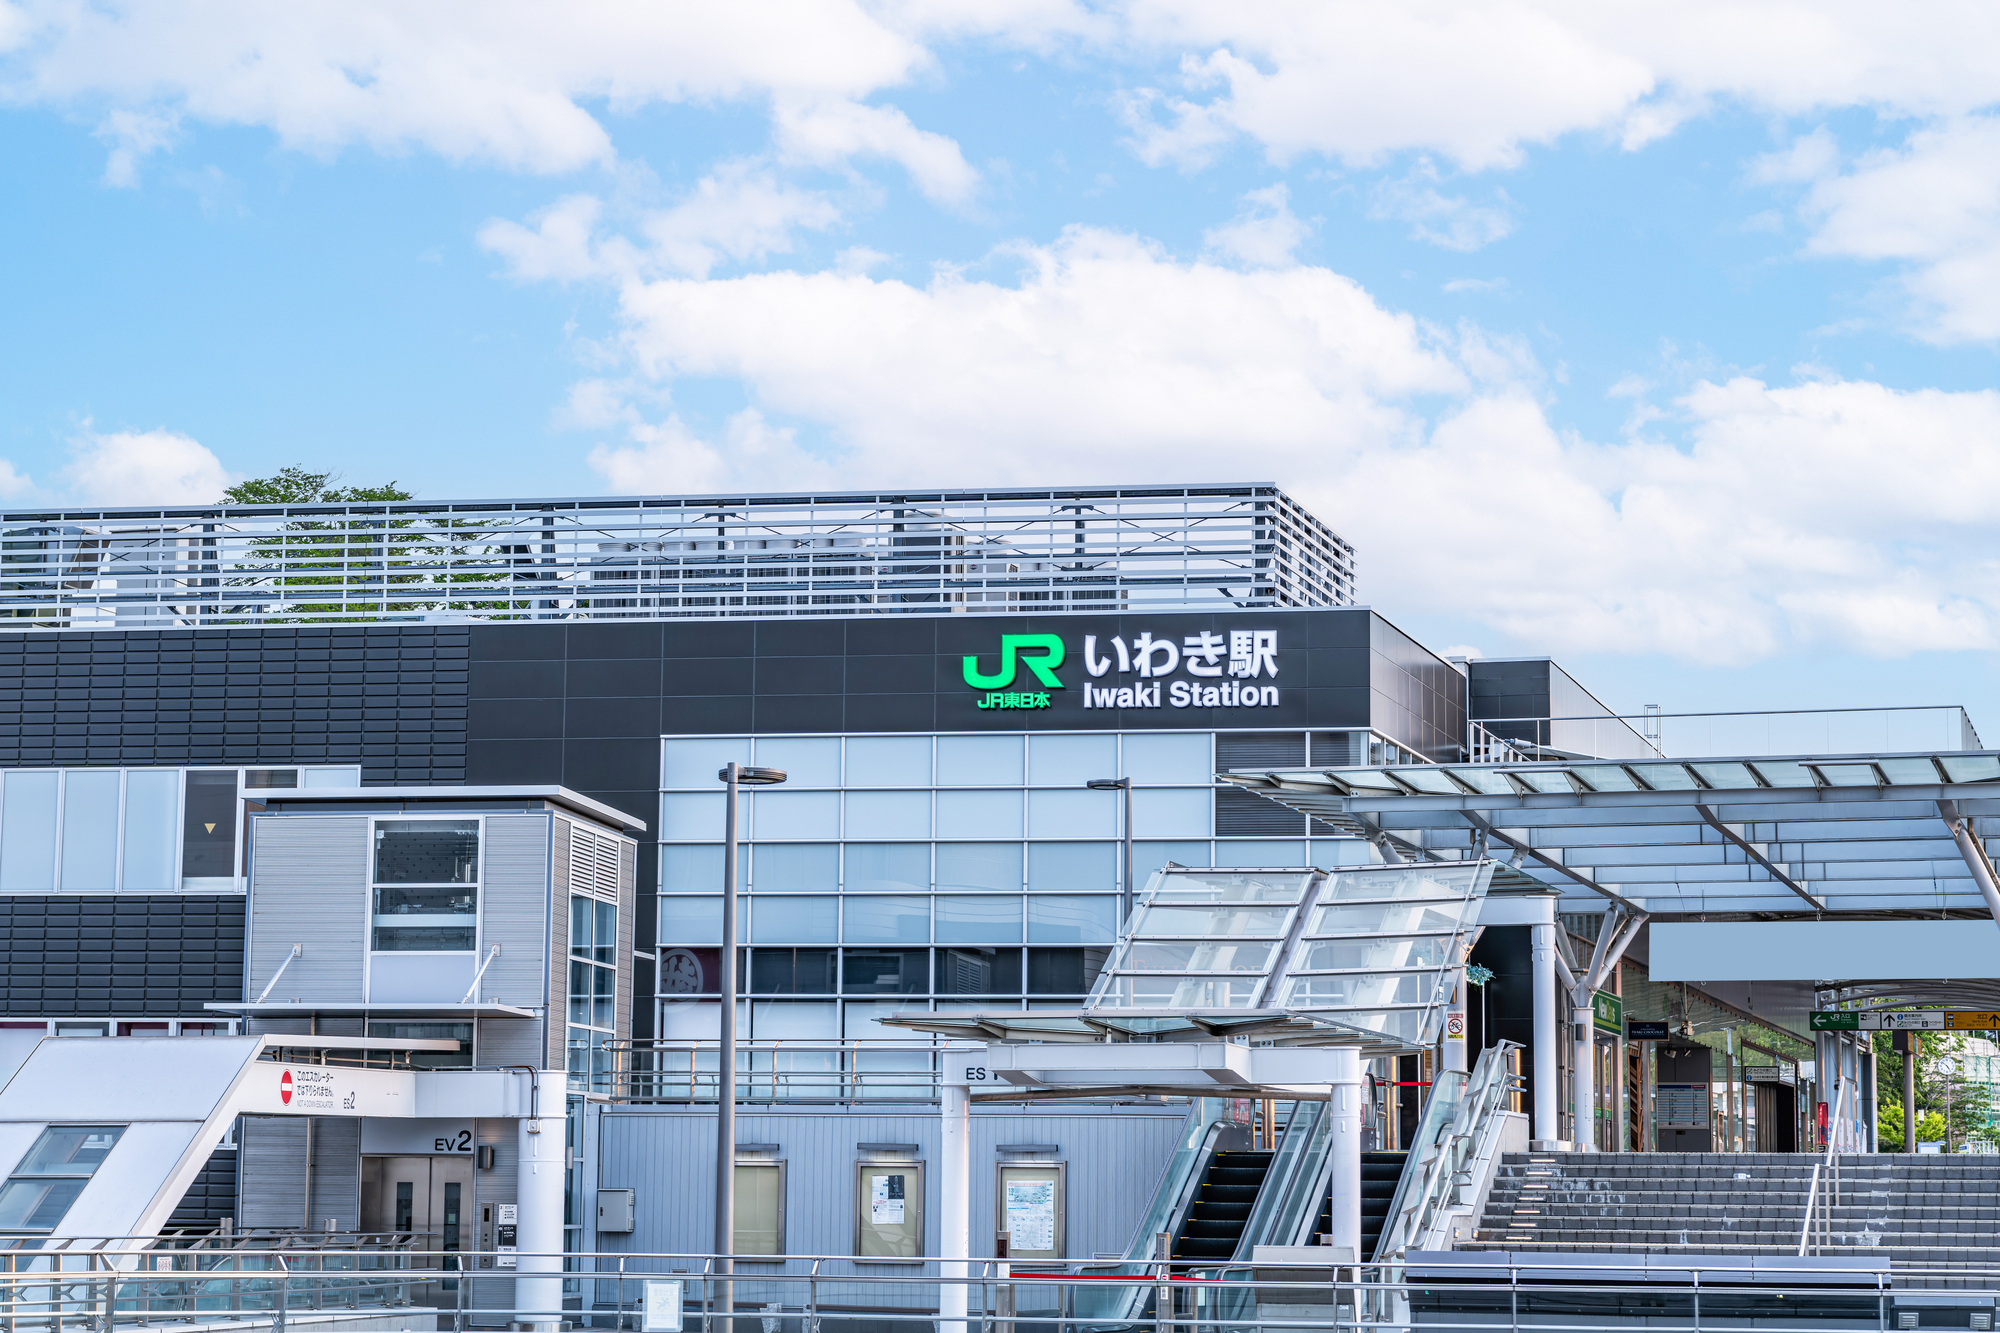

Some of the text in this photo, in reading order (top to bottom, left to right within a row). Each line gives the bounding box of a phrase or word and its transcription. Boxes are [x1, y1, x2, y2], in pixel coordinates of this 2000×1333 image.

[963, 633, 1066, 689] JR
[1084, 630, 1279, 679] いわき駅
[977, 692, 1051, 709] JR東日本
[1083, 680, 1280, 709] Iwaki Station
[297, 1071, 333, 1083] このエスカレーター
[966, 1067, 986, 1081] ES
